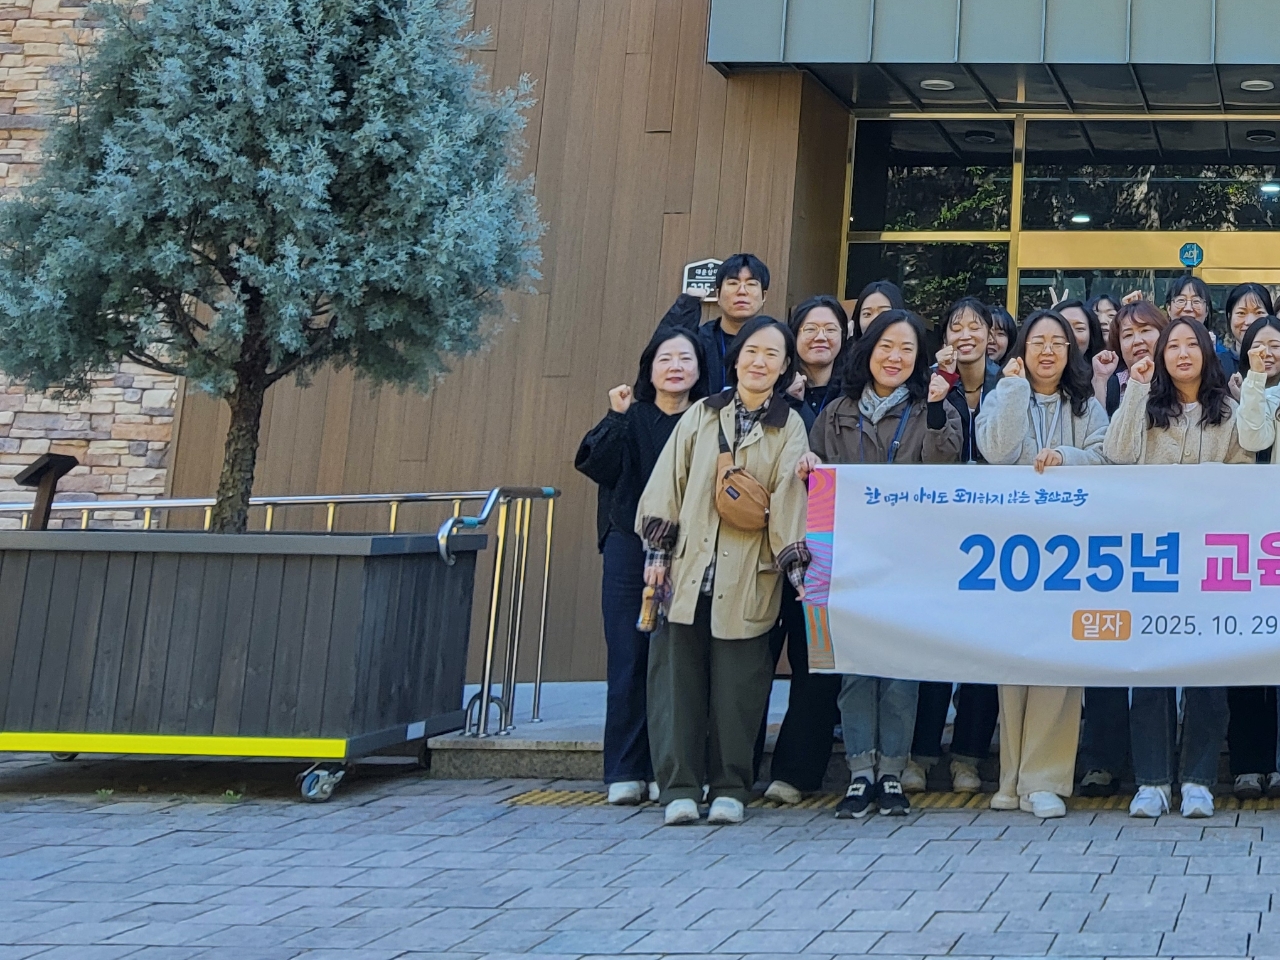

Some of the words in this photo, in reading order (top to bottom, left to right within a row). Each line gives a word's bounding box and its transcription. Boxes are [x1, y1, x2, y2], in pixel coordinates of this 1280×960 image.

[864, 486, 881, 505] 한
[884, 490, 909, 506] 명의
[913, 487, 949, 505] 아이도
[952, 488, 1004, 506] 포기하지
[1007, 489, 1031, 505] 않는
[1034, 488, 1089, 507] 울산교육
[958, 532, 1180, 593] 2025년
[1081, 612, 1124, 638] 일자
[1141, 615, 1202, 636] 2025.
[1212, 615, 1243, 636] 10.
